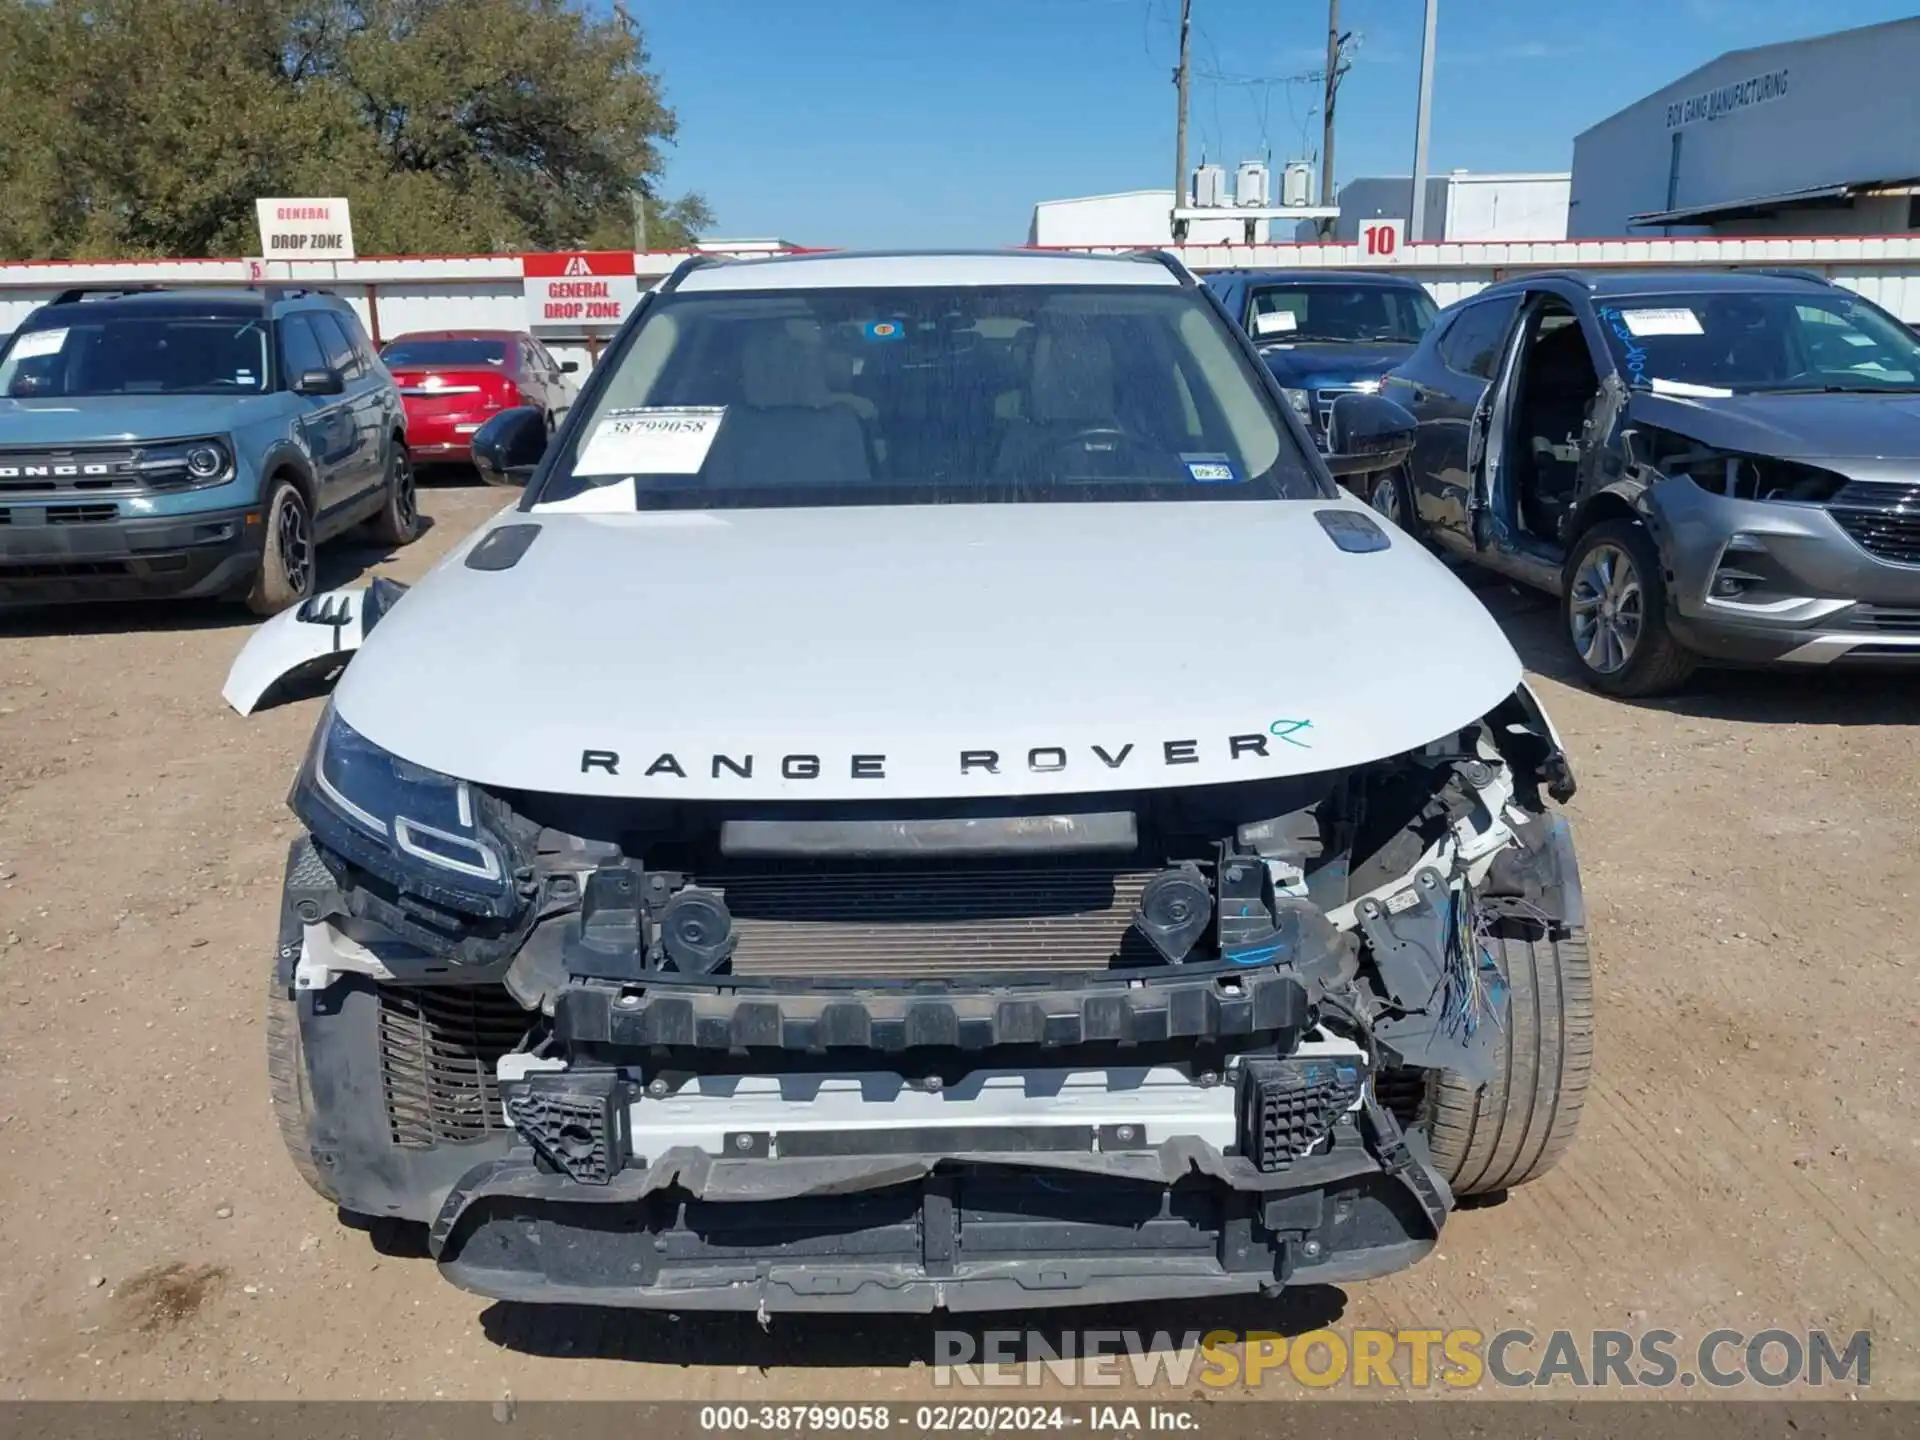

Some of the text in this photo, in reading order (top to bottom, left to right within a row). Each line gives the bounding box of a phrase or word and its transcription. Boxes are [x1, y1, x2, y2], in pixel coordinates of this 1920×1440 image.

[1709, 69, 1788, 116] MANUFACTURING
[277, 207, 329, 220] GENERAL
[271, 234, 343, 249] DROP ZONE
[1364, 226, 1395, 255] 10
[548, 282, 609, 298] GENERAL
[544, 302, 621, 319] DROP ZONE
[611, 420, 707, 433] 38799058
[581, 733, 1270, 780] RANGE ROVER
